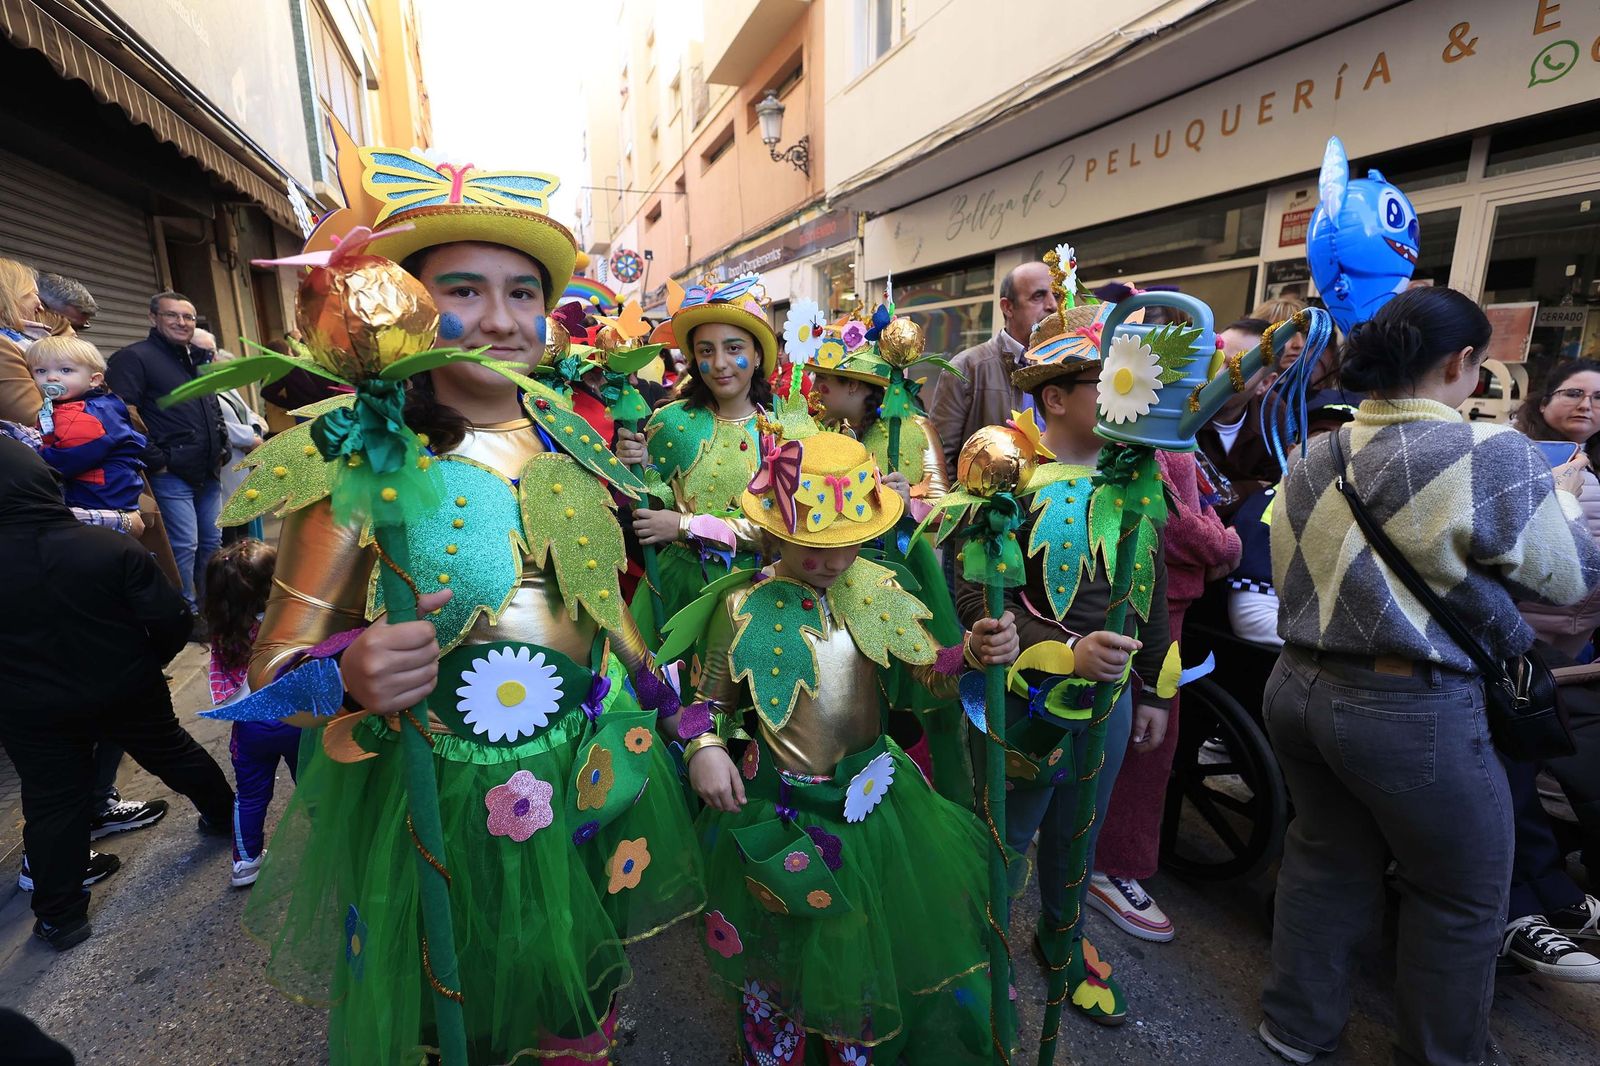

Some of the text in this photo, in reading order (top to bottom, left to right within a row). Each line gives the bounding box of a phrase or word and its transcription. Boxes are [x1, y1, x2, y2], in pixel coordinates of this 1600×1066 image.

[1442, 21, 1479, 64] &
[945, 153, 1076, 241] Belleza de 3
[1540, 311, 1584, 322] CERRADO
